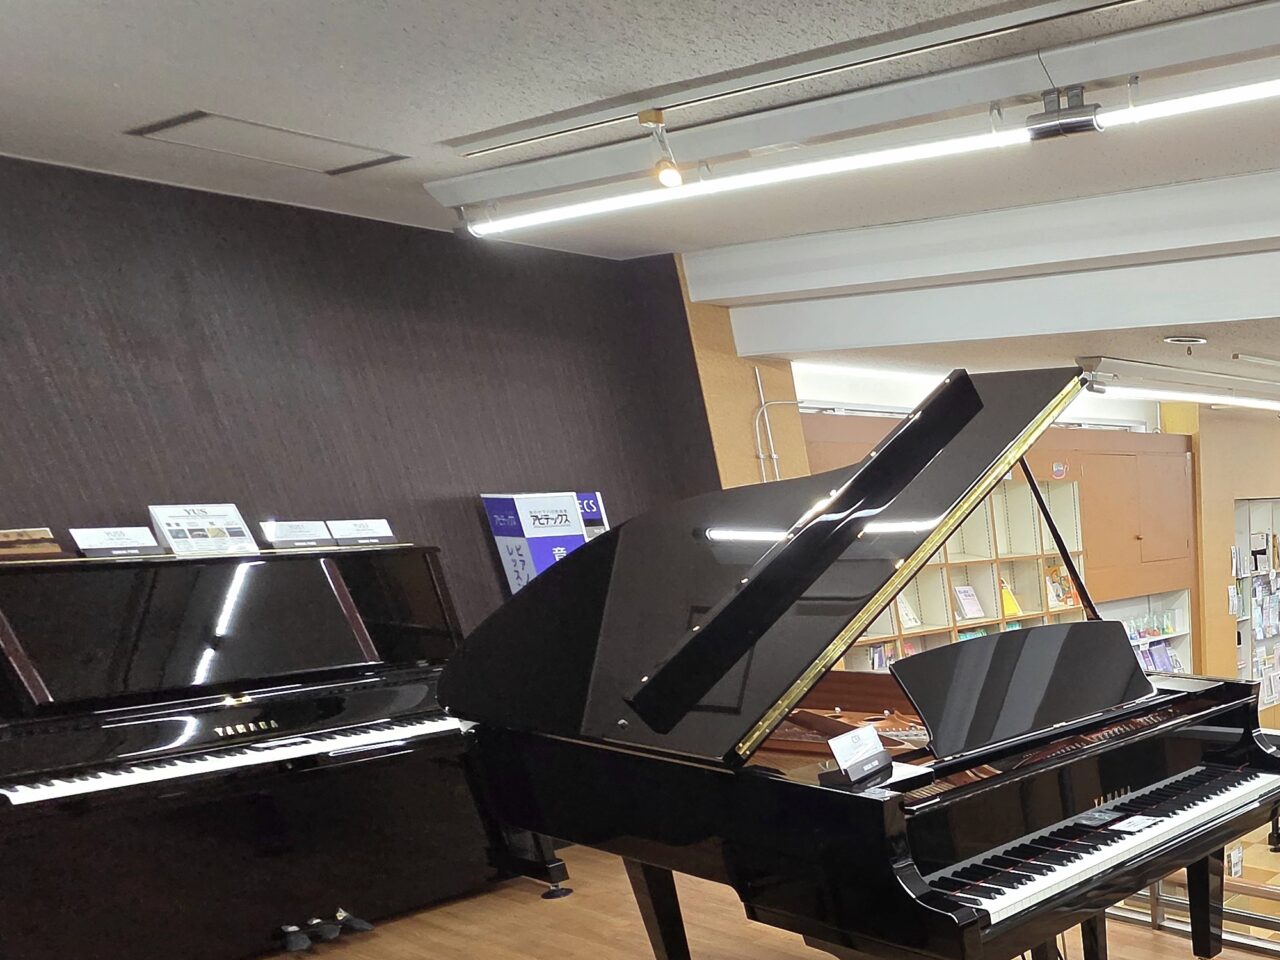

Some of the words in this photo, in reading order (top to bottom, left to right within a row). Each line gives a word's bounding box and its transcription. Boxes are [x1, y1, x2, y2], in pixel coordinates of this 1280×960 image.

[505, 544, 523, 587] レッス
[213, 719, 279, 737] YAMAHA
